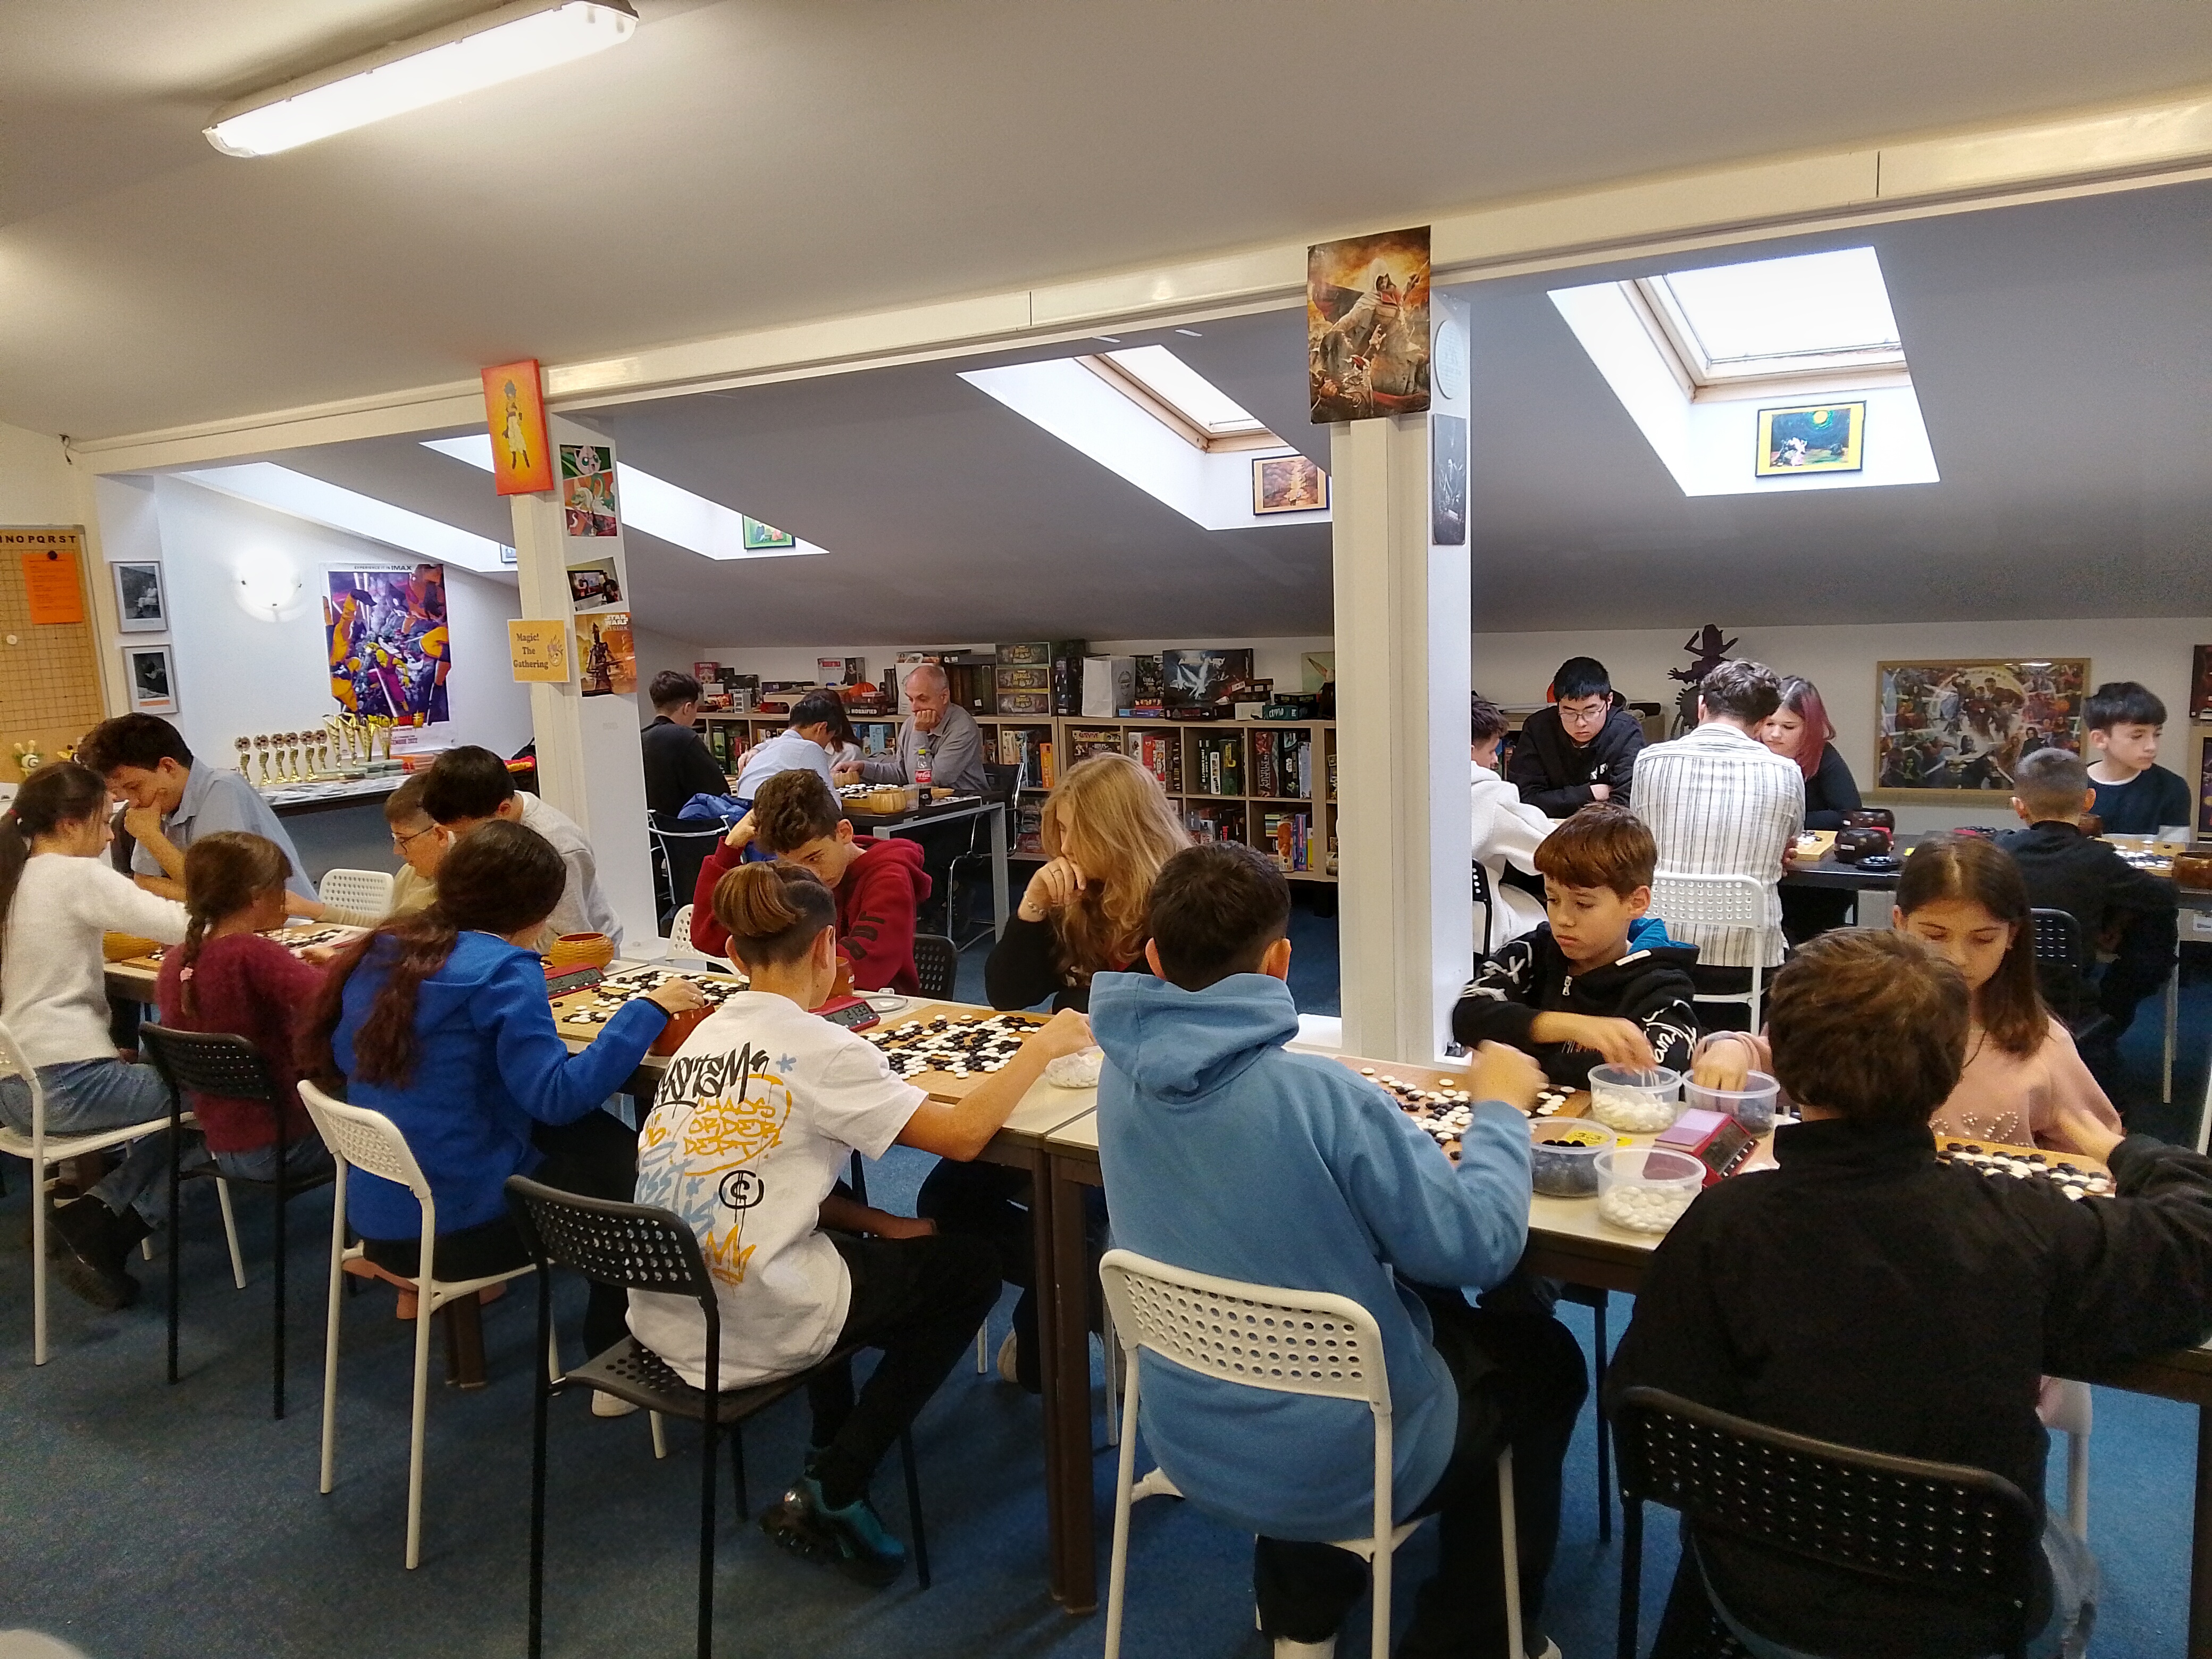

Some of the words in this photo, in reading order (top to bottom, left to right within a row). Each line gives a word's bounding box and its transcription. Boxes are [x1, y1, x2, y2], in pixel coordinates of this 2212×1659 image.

[0, 535, 76, 543] NOPQRST
[604, 617, 629, 625] WARS
[516, 633, 539, 642] Magic!
[522, 647, 535, 655] The
[513, 659, 549, 671] Gathering
[695, 1096, 776, 1118] CHAOS
[689, 1117, 782, 1144] ORDER
[683, 1136, 758, 1159] DEPT
